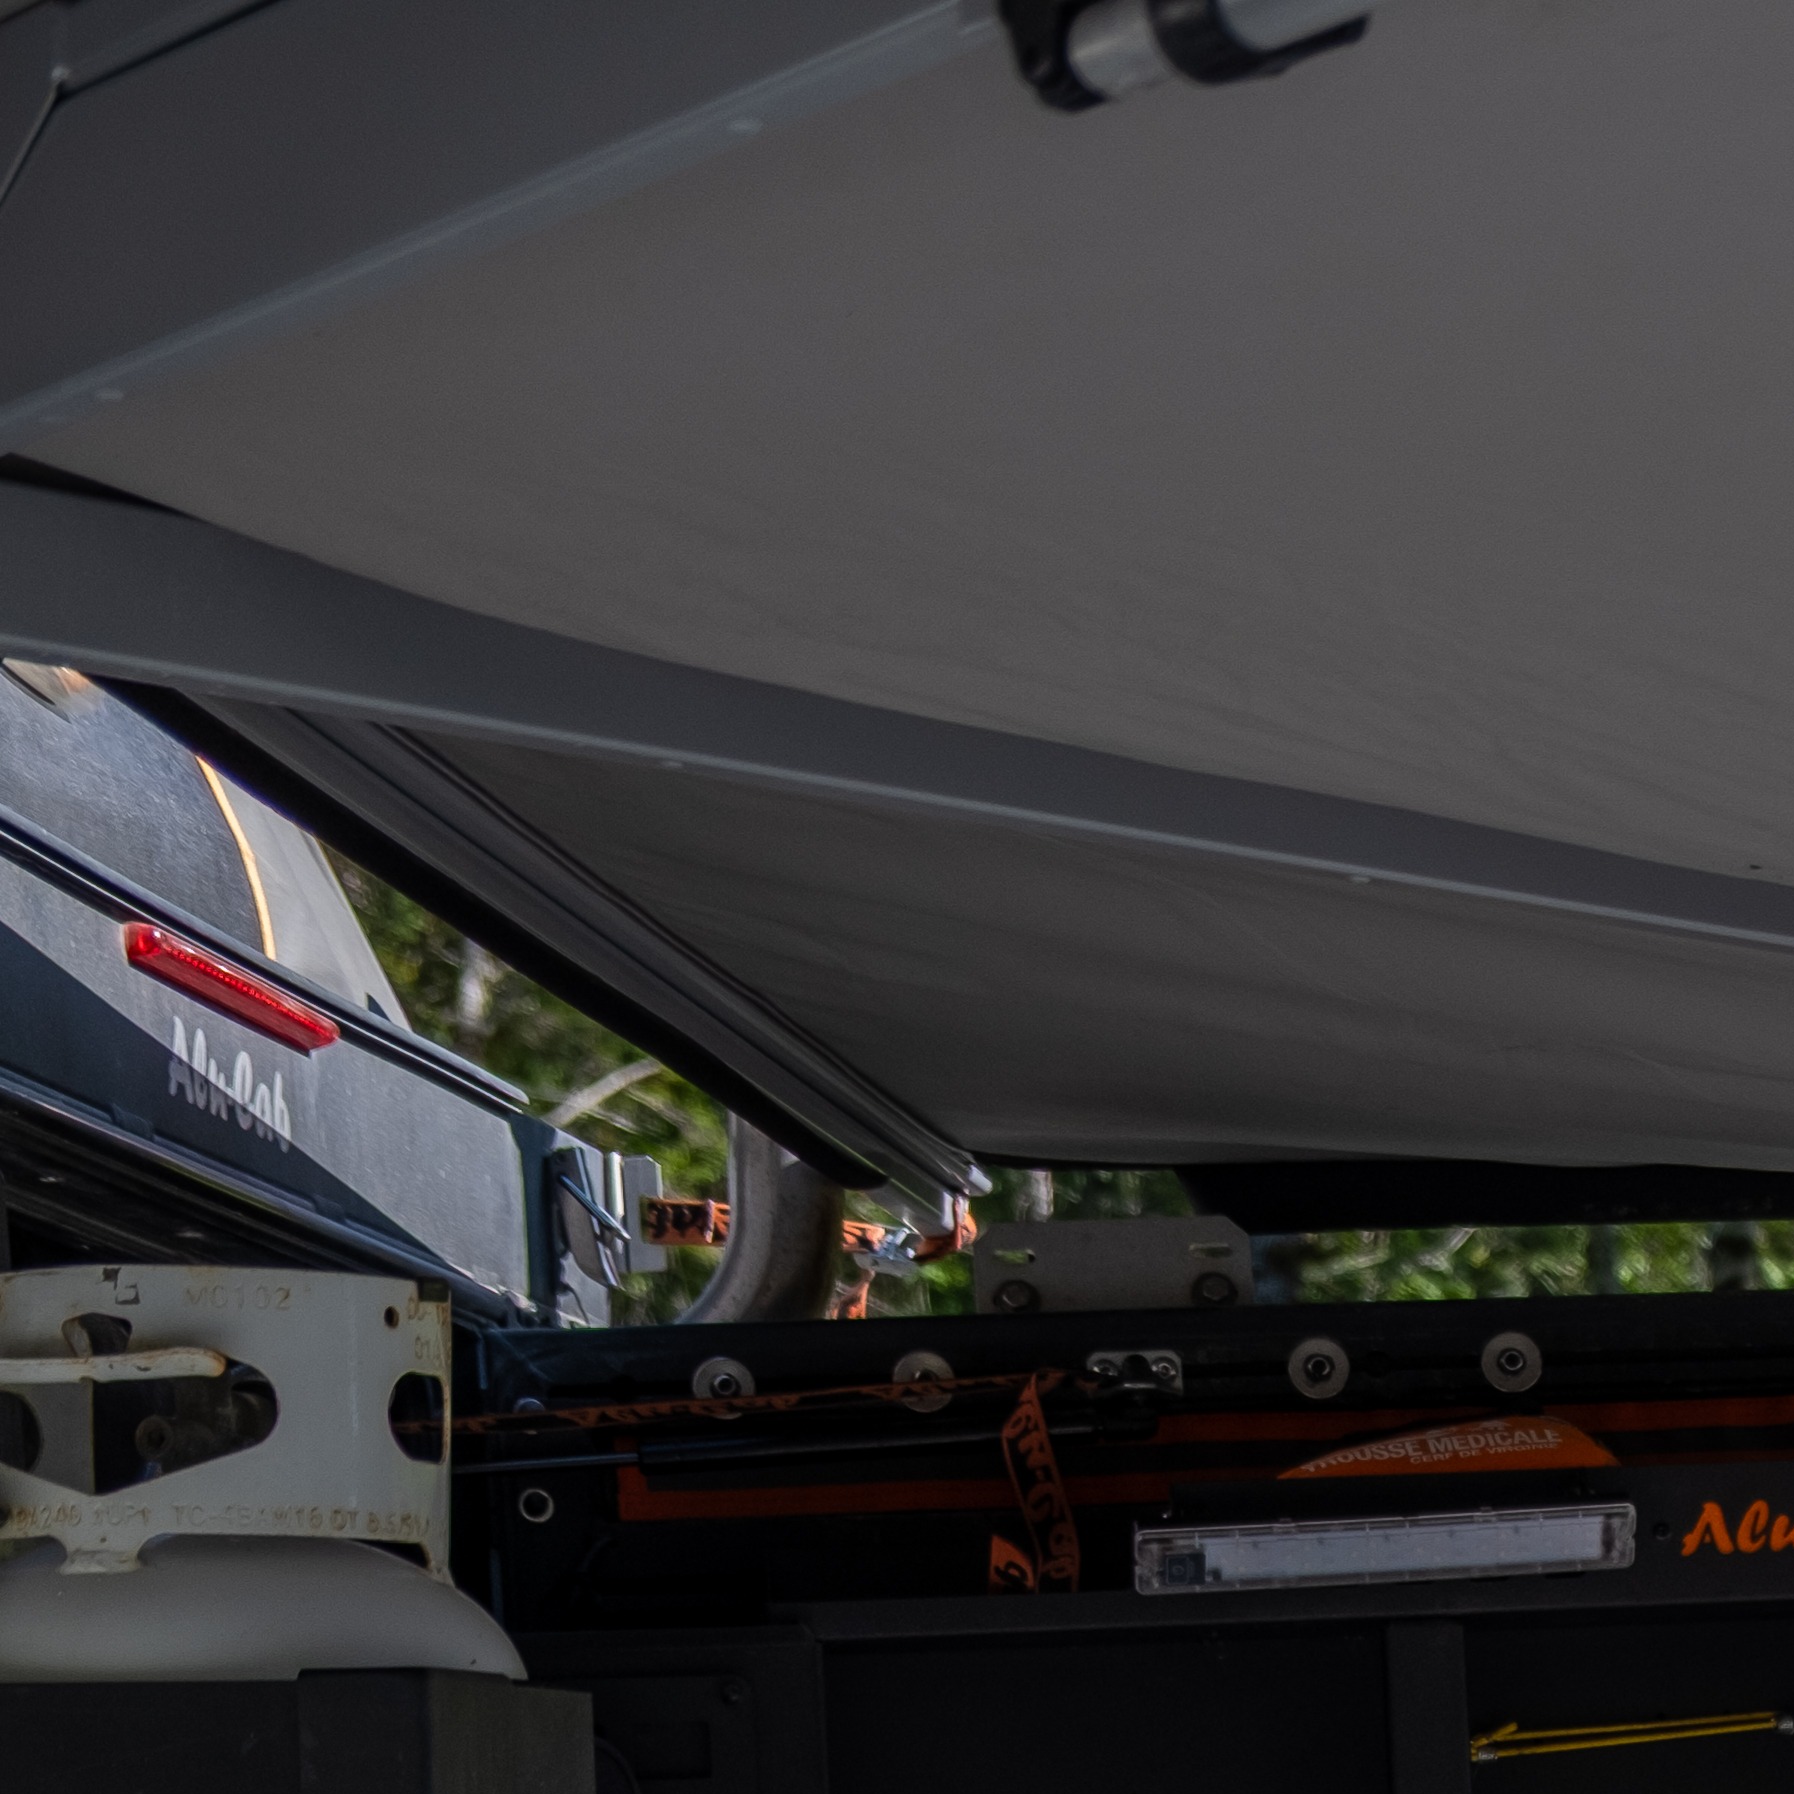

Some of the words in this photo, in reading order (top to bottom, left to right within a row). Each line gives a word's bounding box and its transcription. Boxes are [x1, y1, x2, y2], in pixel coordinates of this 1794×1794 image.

[168, 1015, 291, 1153] Alu-Cab
[1427, 1428, 1563, 1454] MEDICALE
[1410, 1452, 1454, 1464] CERF
[1460, 1449, 1482, 1459] DE
